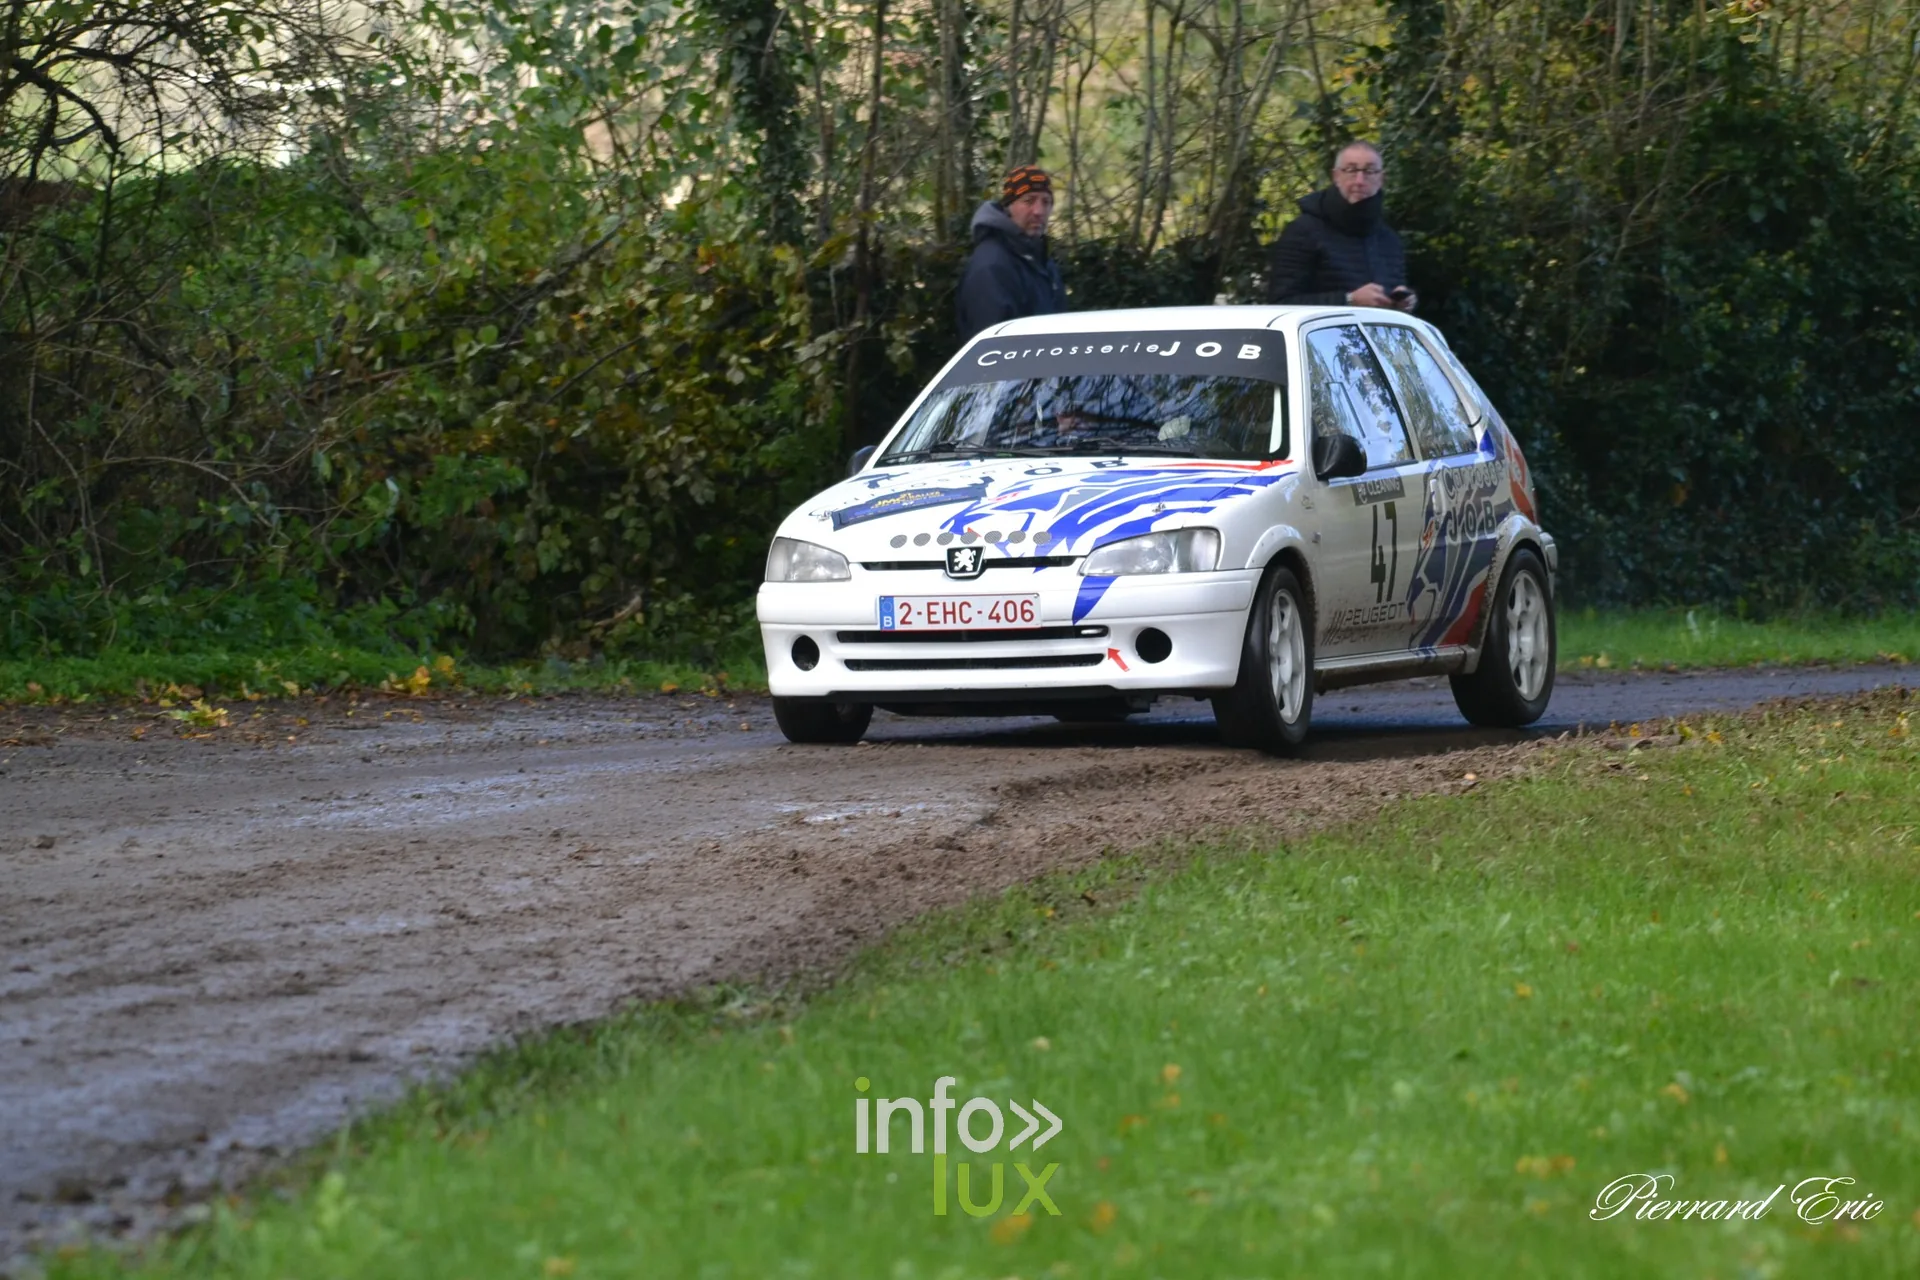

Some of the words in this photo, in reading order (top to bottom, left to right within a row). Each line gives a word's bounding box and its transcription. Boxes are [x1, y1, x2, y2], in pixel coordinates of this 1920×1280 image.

[977, 342, 1160, 367] Carrosserie
[1159, 340, 1263, 361] JOB
[1447, 499, 1497, 542] JOB
[883, 615, 893, 628] B
[899, 600, 1035, 625] 2-EHC-406
[1343, 602, 1405, 626] PEUGEOT
